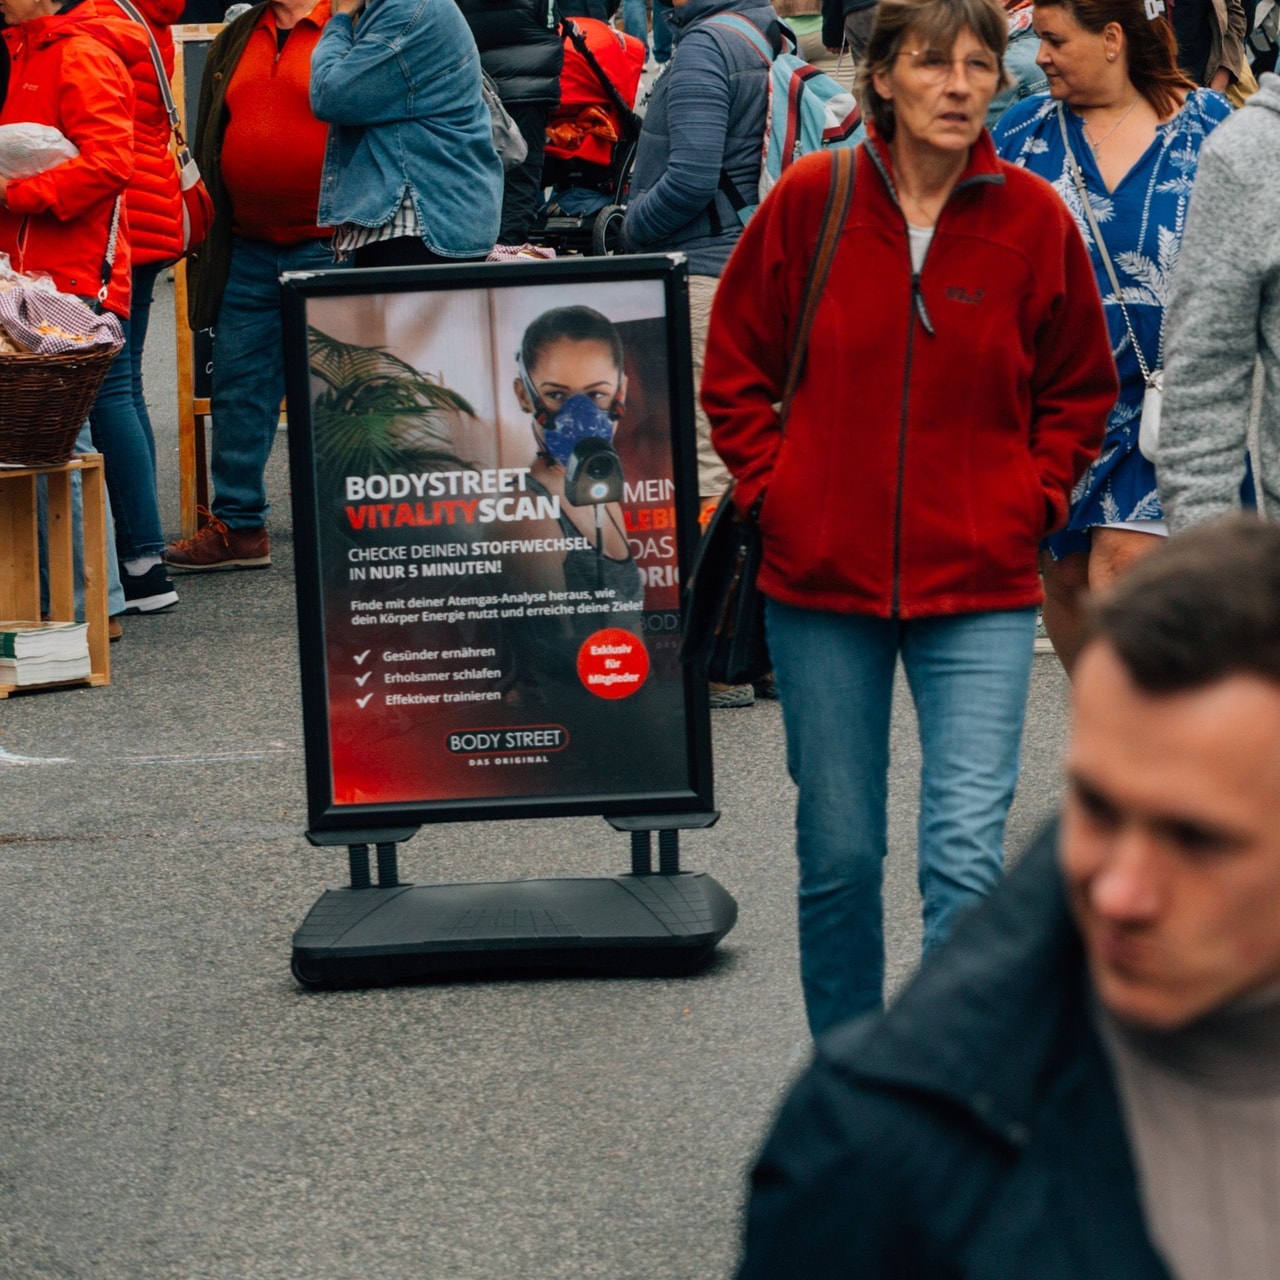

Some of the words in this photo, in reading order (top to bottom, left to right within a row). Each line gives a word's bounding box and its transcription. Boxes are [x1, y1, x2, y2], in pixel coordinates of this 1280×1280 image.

[345, 467, 531, 500] BODYSTREET
[345, 495, 561, 529] VITALITYSCAN
[624, 507, 676, 531] LEB
[348, 546, 407, 562] CHECKE
[411, 543, 468, 559] DEINEN
[471, 537, 592, 557] STOFFWECHSEL
[628, 536, 675, 560] DAS
[349, 567, 366, 581] IN
[370, 565, 405, 579] NUR
[408, 564, 418, 578] 5
[422, 560, 502, 577] MINUTEN!
[351, 600, 383, 611] Finde
[385, 598, 405, 609] mit
[407, 597, 445, 609] deiner
[447, 592, 546, 609] Atemgas-Analyse
[549, 589, 592, 601] heraus,
[595, 588, 616, 599] wie
[351, 614, 377, 625] dein
[379, 611, 419, 625] Körper
[422, 609, 466, 623] Energie
[467, 608, 498, 619] nutzt
[501, 607, 524, 617] und
[526, 603, 574, 616] erreiche
[577, 602, 610, 614] deine
[612, 600, 644, 612] Ziele!
[383, 648, 439, 662] Gesünder
[441, 646, 496, 659] ernähren
[590, 644, 632, 656] Exklusiv
[605, 658, 622, 669] für
[384, 671, 450, 684] Erholsamer
[452, 668, 501, 681] schlafen
[588, 672, 640, 686] Mitglieder
[385, 692, 441, 706] Effektiver
[443, 690, 501, 703] trainieren
[450, 733, 501, 751] BODY
[505, 730, 562, 748] STREET
[468, 757, 490, 767] DAS
[495, 755, 549, 765] ORIGINAL
